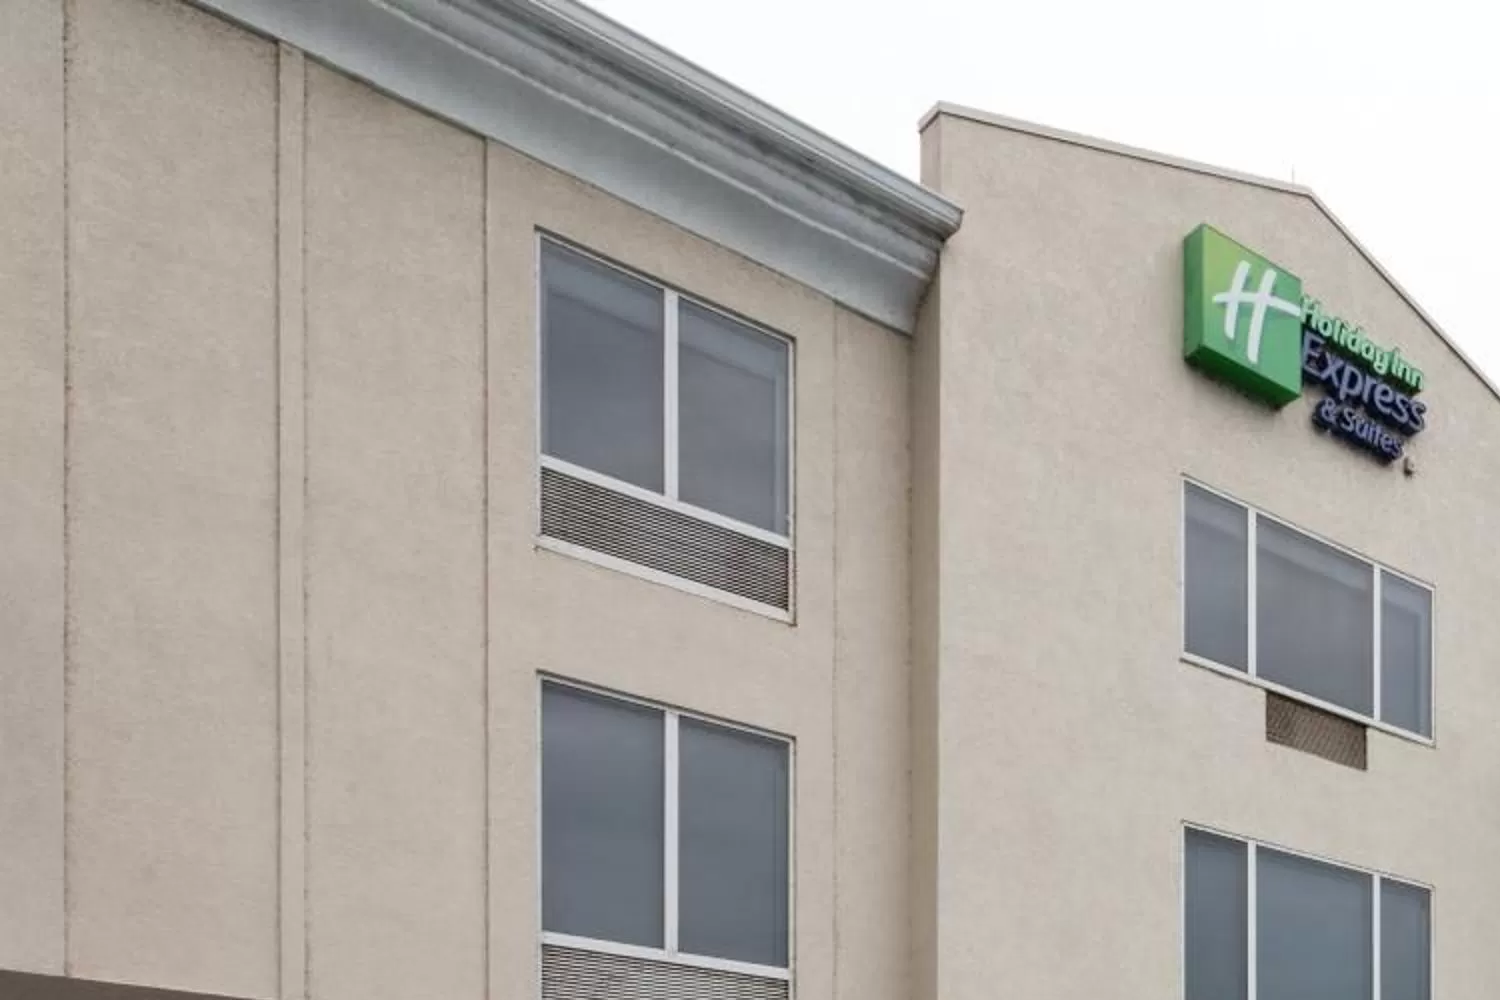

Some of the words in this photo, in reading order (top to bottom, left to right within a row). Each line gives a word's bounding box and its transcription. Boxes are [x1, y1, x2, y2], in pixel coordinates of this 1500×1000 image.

[1301, 295, 1389, 375] Holiday
[1391, 349, 1424, 390] Inn
[1301, 331, 1428, 431] Express
[1320, 397, 1338, 424] &
[1340, 406, 1404, 457] Suites
